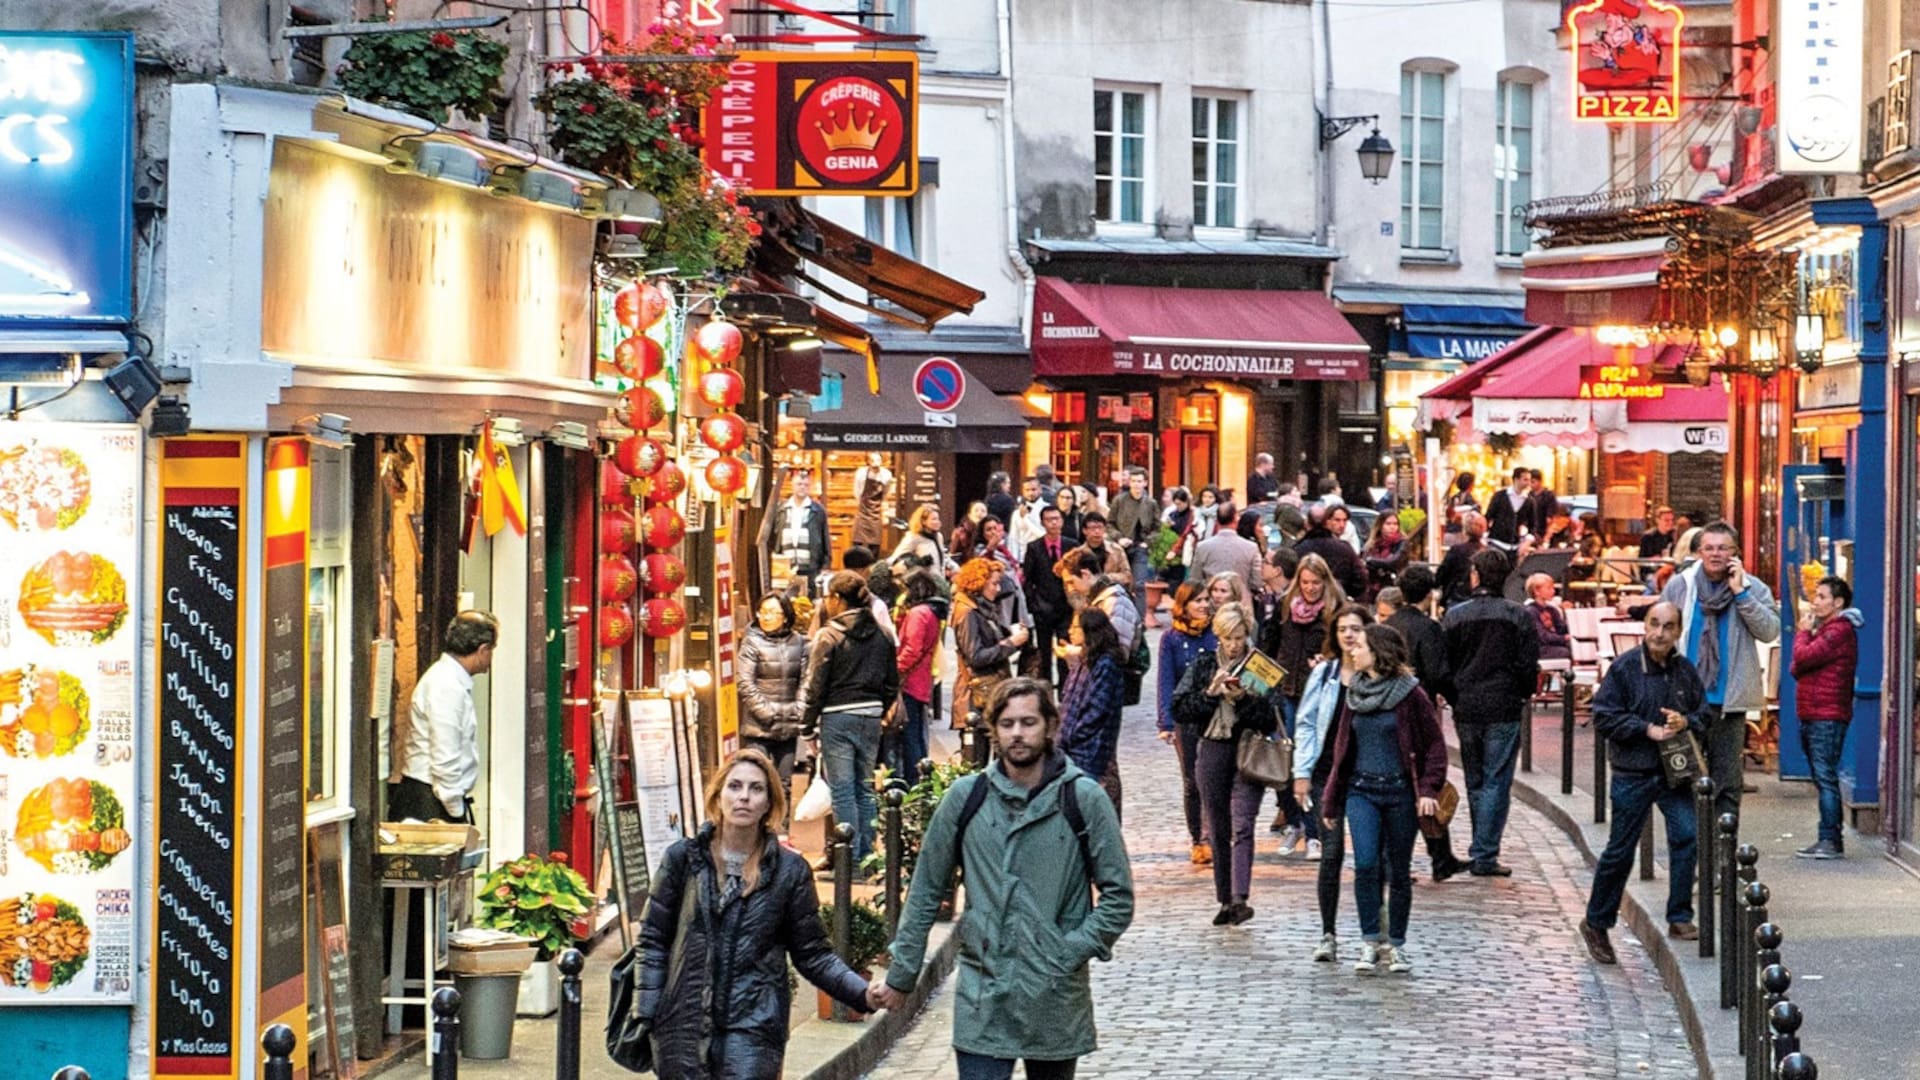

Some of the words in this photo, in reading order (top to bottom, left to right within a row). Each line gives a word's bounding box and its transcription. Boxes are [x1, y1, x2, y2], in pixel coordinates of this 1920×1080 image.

[821, 82, 881, 108] CRÊPERIE
[1580, 97, 1673, 117] PIZZA
[825, 156, 878, 169] GENIA
[1043, 312, 1054, 323] LA
[1043, 327, 1099, 337] COCHONNAILLE
[1439, 339, 1461, 357] LA
[1143, 353, 1163, 369] LA
[1170, 355, 1294, 374] COCHONNAILLE
[1580, 382, 1591, 398] A
[843, 433, 883, 443] GEORGES
[171, 720, 225, 783] BRAVAS
[96, 889, 131, 901] CHICKEN
[96, 903, 131, 915] CHIKA
